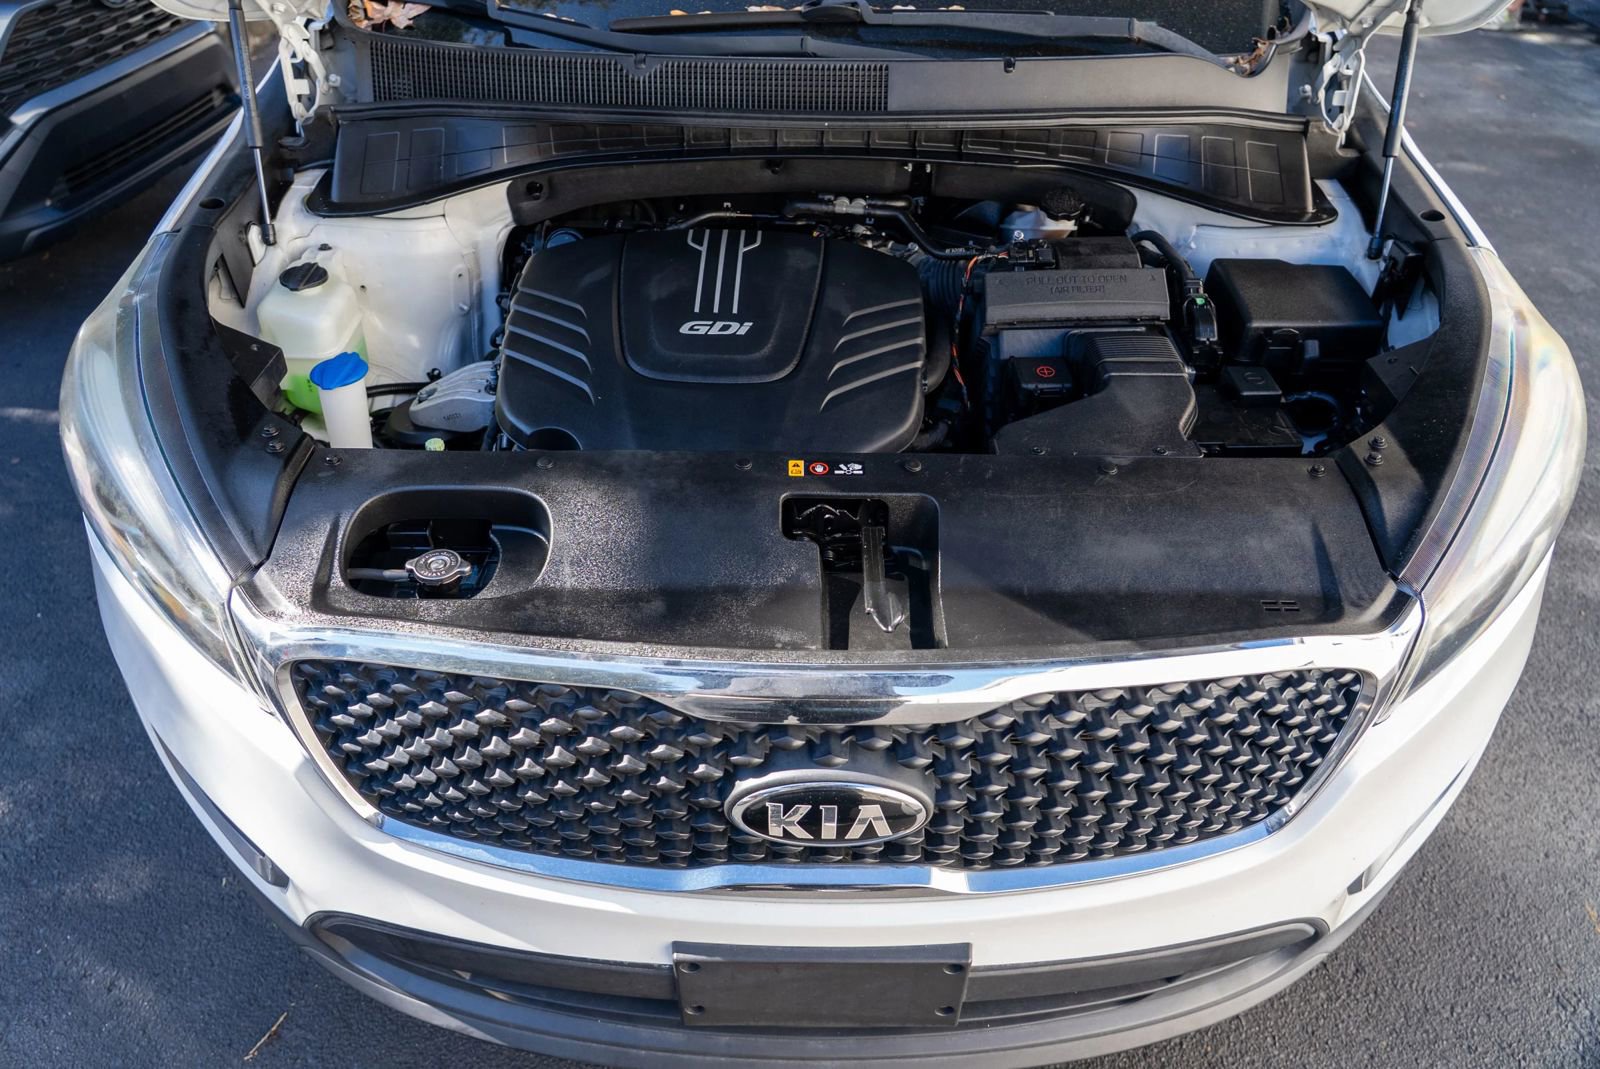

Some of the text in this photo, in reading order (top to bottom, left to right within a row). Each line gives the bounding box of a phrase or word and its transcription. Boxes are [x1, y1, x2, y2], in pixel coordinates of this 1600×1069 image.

[1025, 275, 1127, 285] PULL OUT TO OPEN
[679, 320, 754, 335] GDi
[765, 802, 893, 840] KIA
